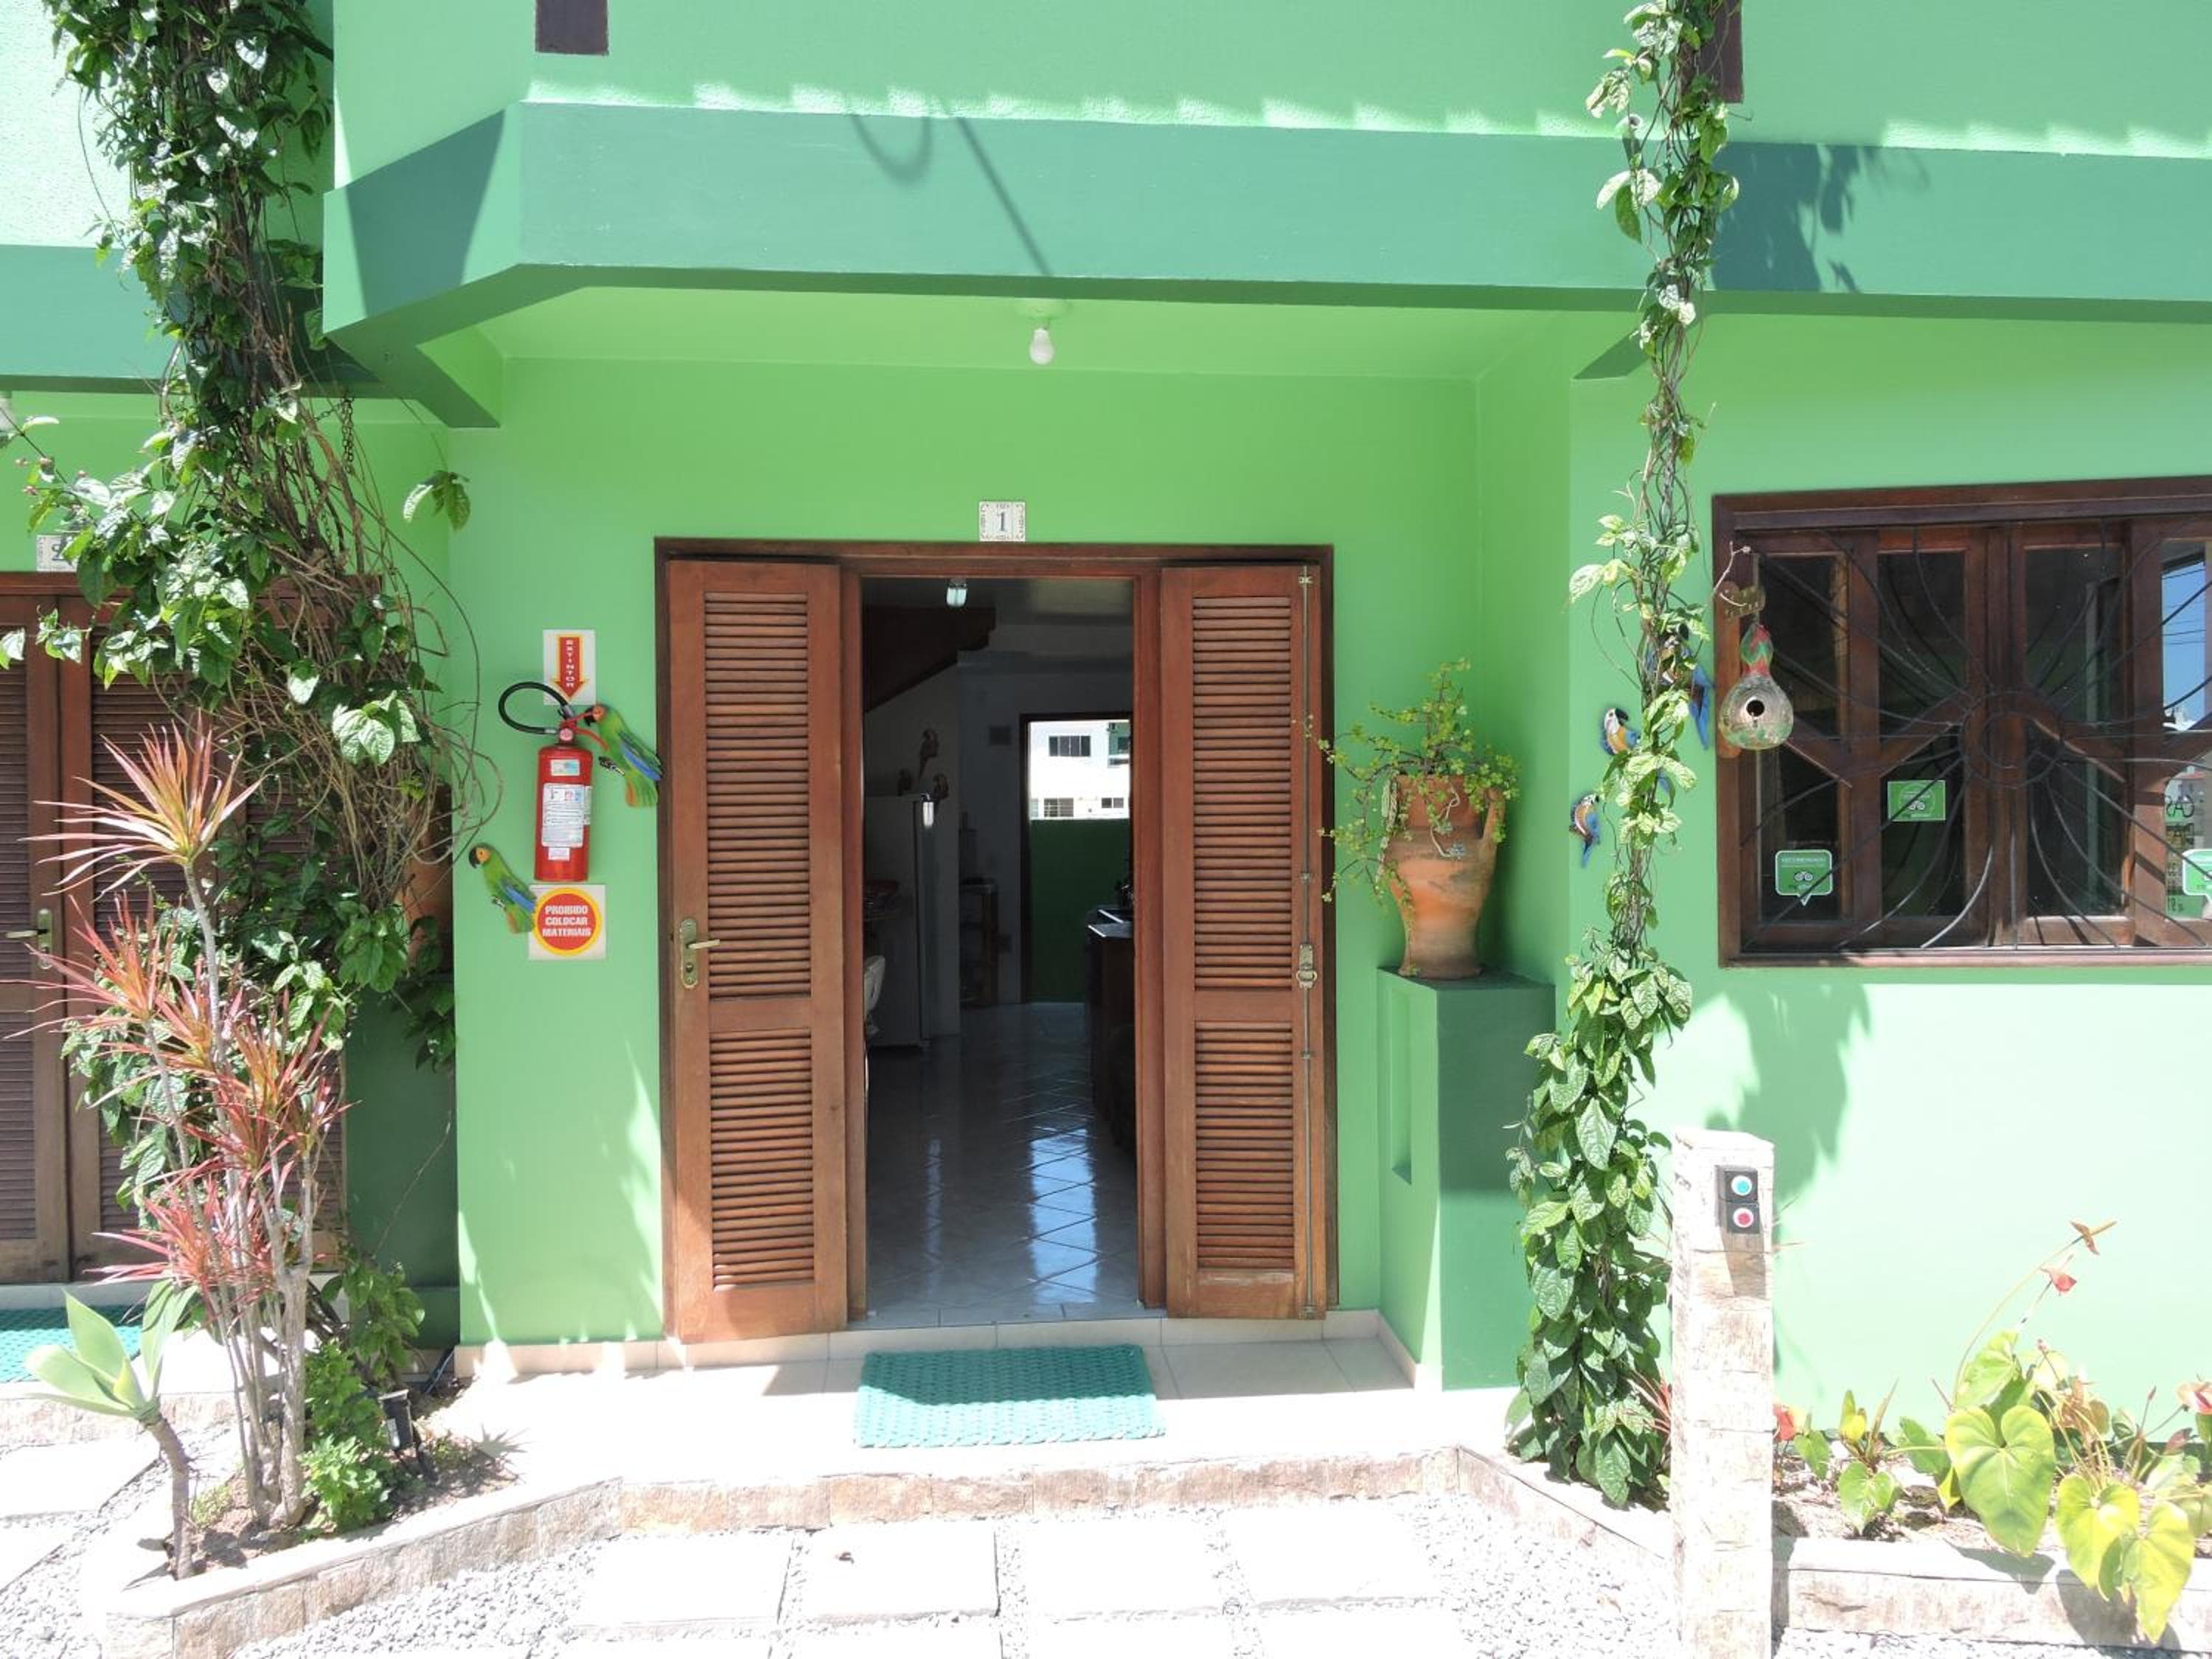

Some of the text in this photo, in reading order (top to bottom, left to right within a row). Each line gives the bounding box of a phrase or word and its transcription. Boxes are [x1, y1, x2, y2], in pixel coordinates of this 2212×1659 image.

[998, 512, 1008, 532] 1
[566, 639, 574, 688] EXTINTOR
[545, 905, 588, 915] PROIBIDO
[545, 917, 588, 925] COLOCAR
[542, 928, 591, 937] MATERIAIS
